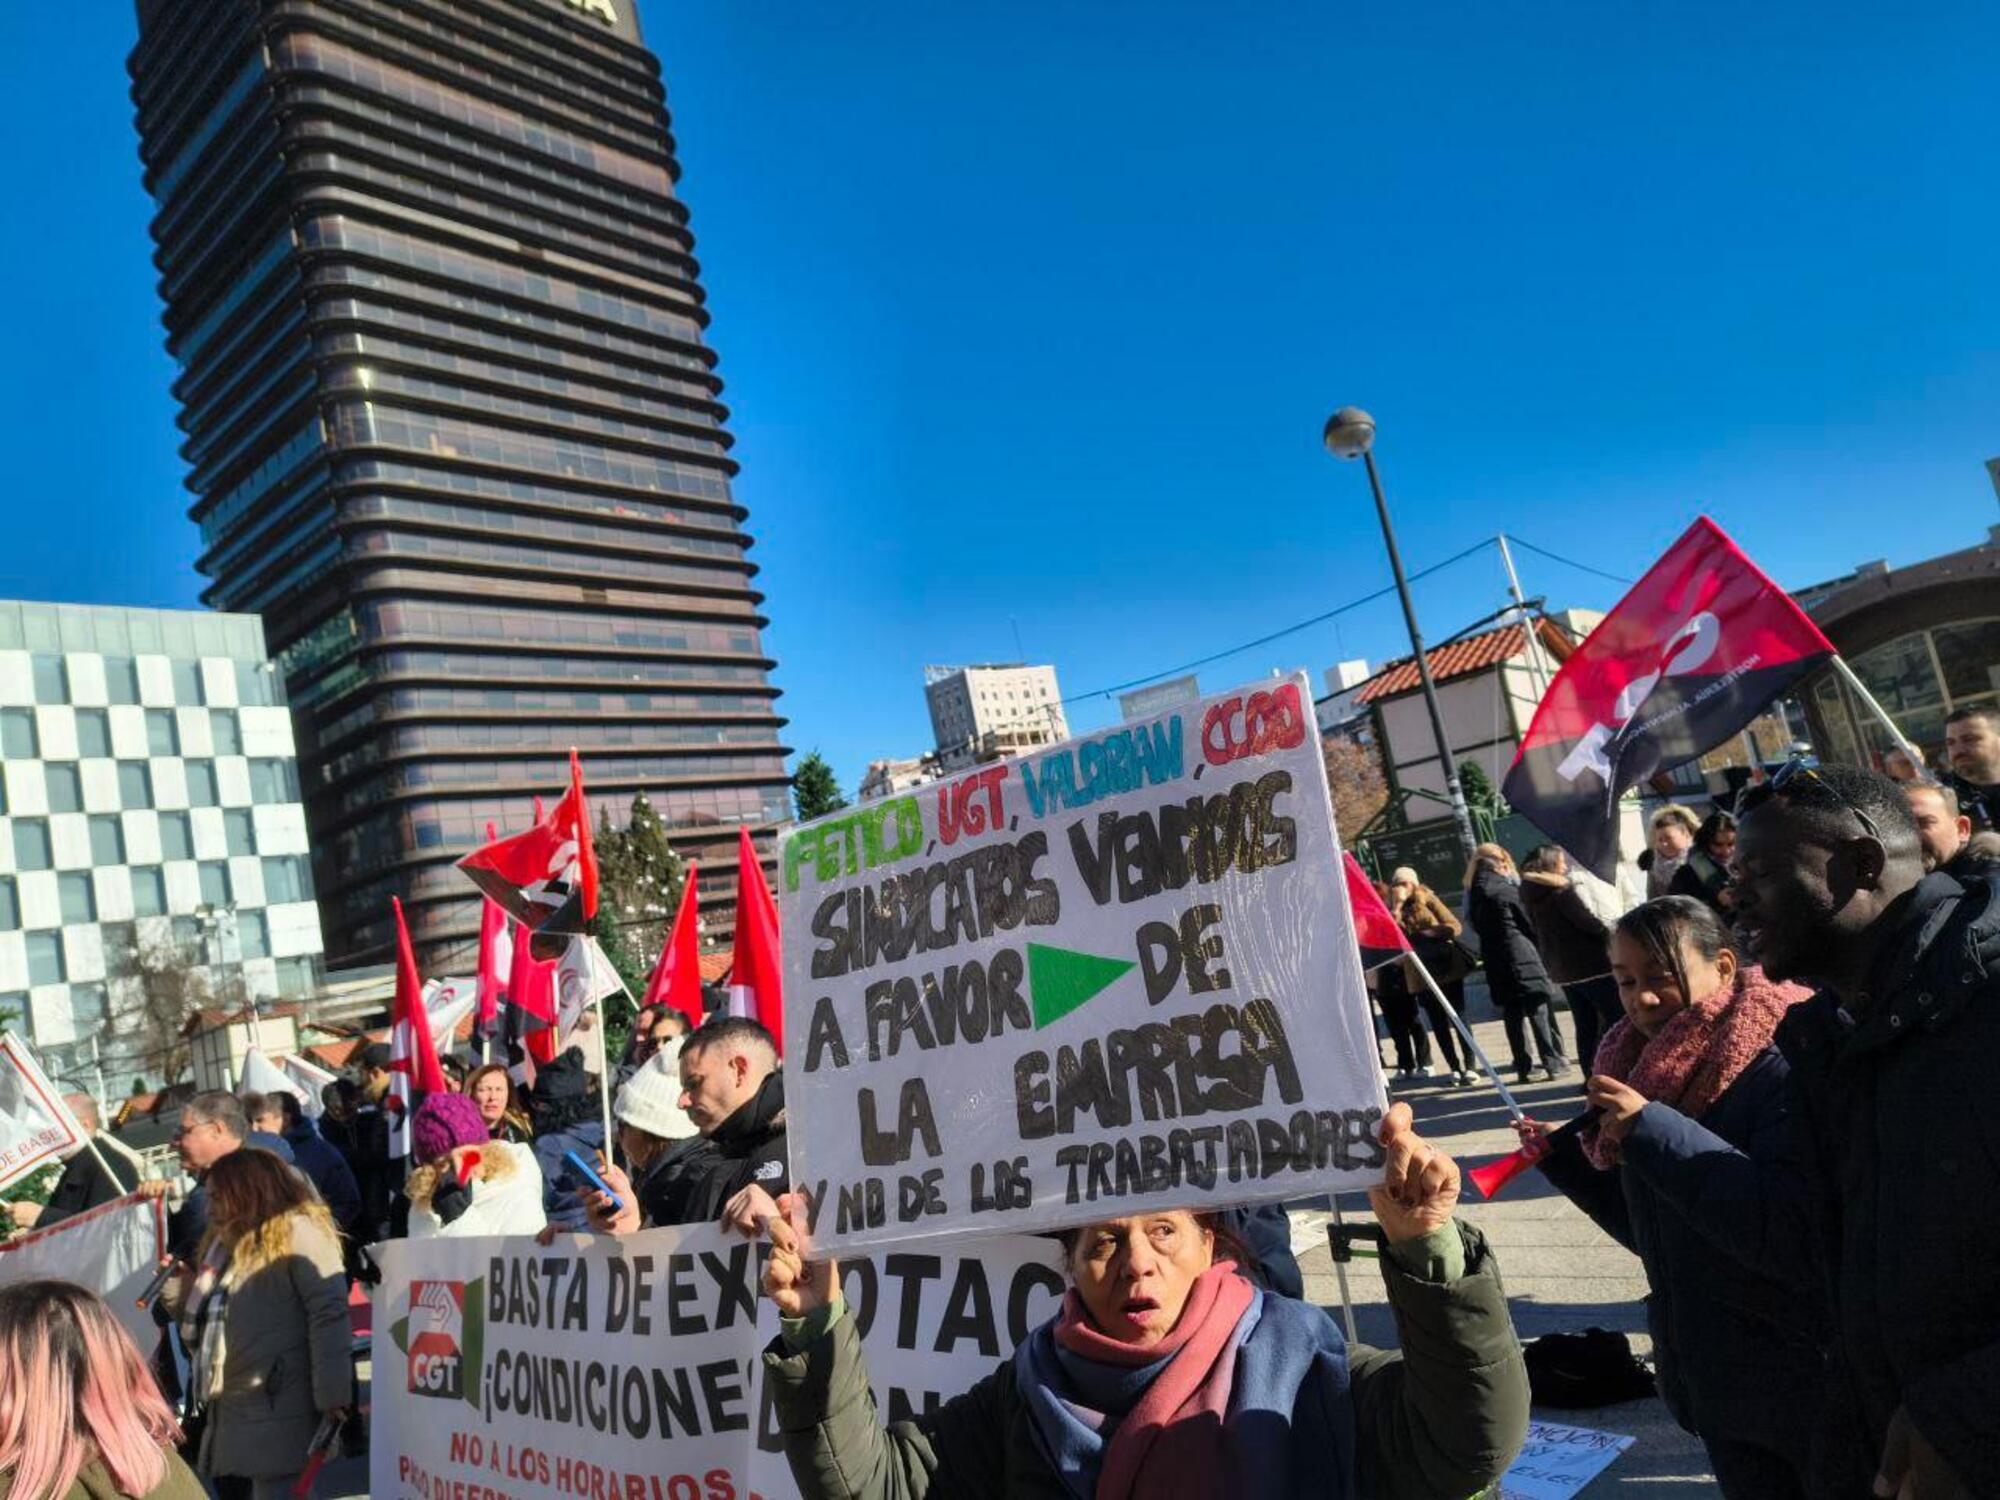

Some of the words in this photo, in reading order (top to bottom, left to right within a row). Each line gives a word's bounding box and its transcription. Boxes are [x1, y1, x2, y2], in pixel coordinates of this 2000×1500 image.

[1201, 683, 1306, 766] CCOO
[811, 830, 1061, 979] SINDICATOS
[1066, 770, 1298, 905] VENDIDOS
[804, 996, 849, 1072] A
[865, 948, 1031, 1061] FAVOR
[1136, 903, 1232, 1007] DE
[857, 1077, 943, 1166] LA
[1013, 998, 1304, 1140] EMPRESA
[798, 1179, 828, 1237] Y
[836, 1177, 886, 1234] NO
[898, 1168, 947, 1222] DE
[970, 1155, 1032, 1213] LOS
[1056, 1106, 1388, 1204] TRABAJADORES
[488, 1255, 589, 1333] BASTA
[605, 1255, 655, 1336] DE
[414, 1352, 458, 1393] CGT
[485, 1347, 753, 1441] ¡CONDICIONE
[450, 1431, 484, 1467] NO
[490, 1441, 501, 1473] A
[507, 1445, 550, 1486] LOS
[556, 1455, 737, 1500] HORARIOS
